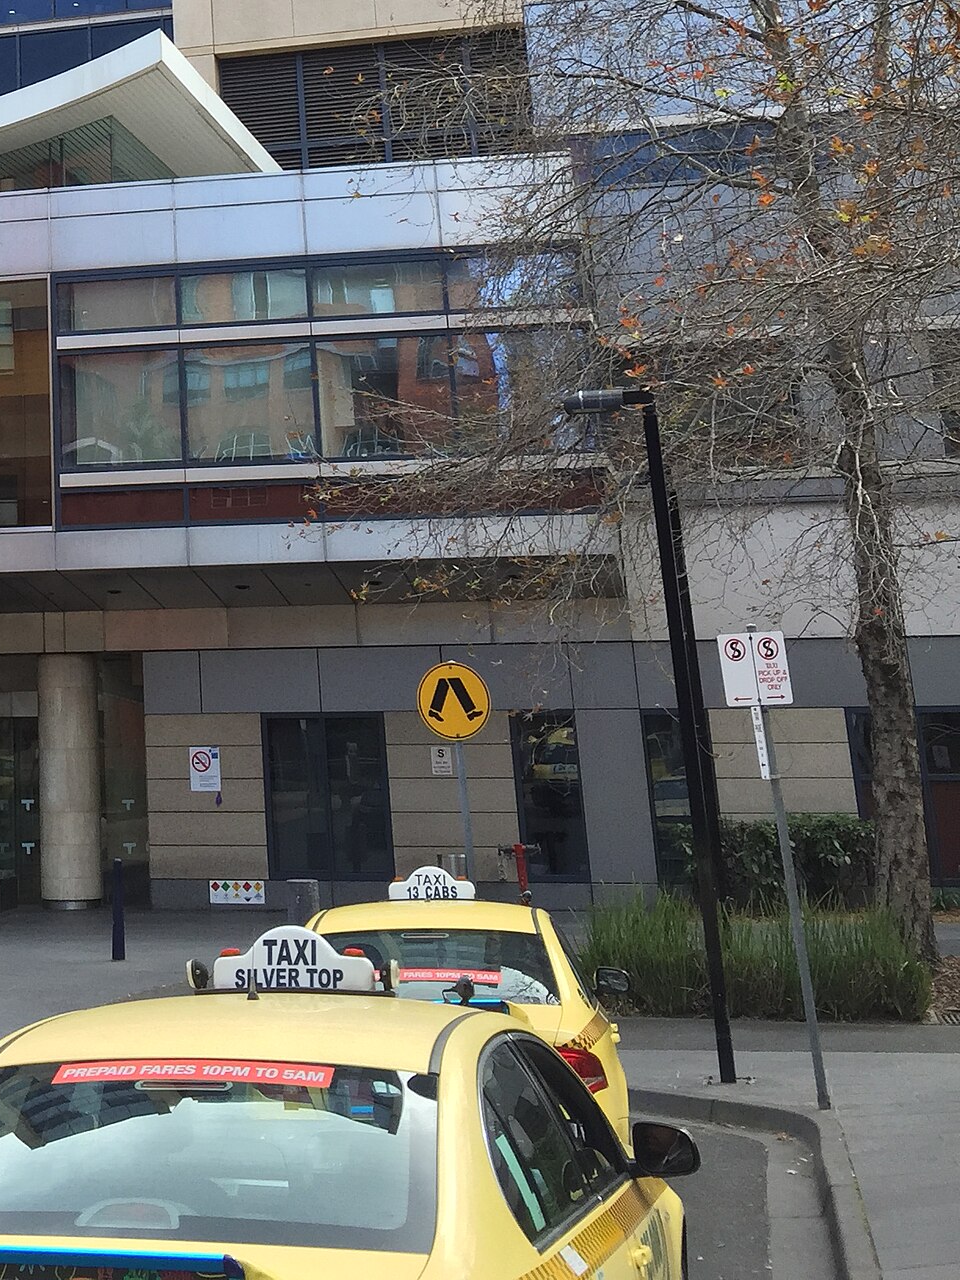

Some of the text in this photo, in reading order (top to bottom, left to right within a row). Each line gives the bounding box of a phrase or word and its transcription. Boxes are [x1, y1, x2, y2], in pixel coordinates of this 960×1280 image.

[437, 749, 445, 758] S
[415, 874, 447, 886] TAXI
[407, 886, 458, 899] 13 CABS
[263, 939, 317, 966] TAXI
[234, 968, 344, 989] SILVER TOP
[403, 971, 433, 979] FARES
[435, 972, 461, 980] 10PM
[62, 1064, 325, 1083] PREPAID FARES 10PM TO 5AM
